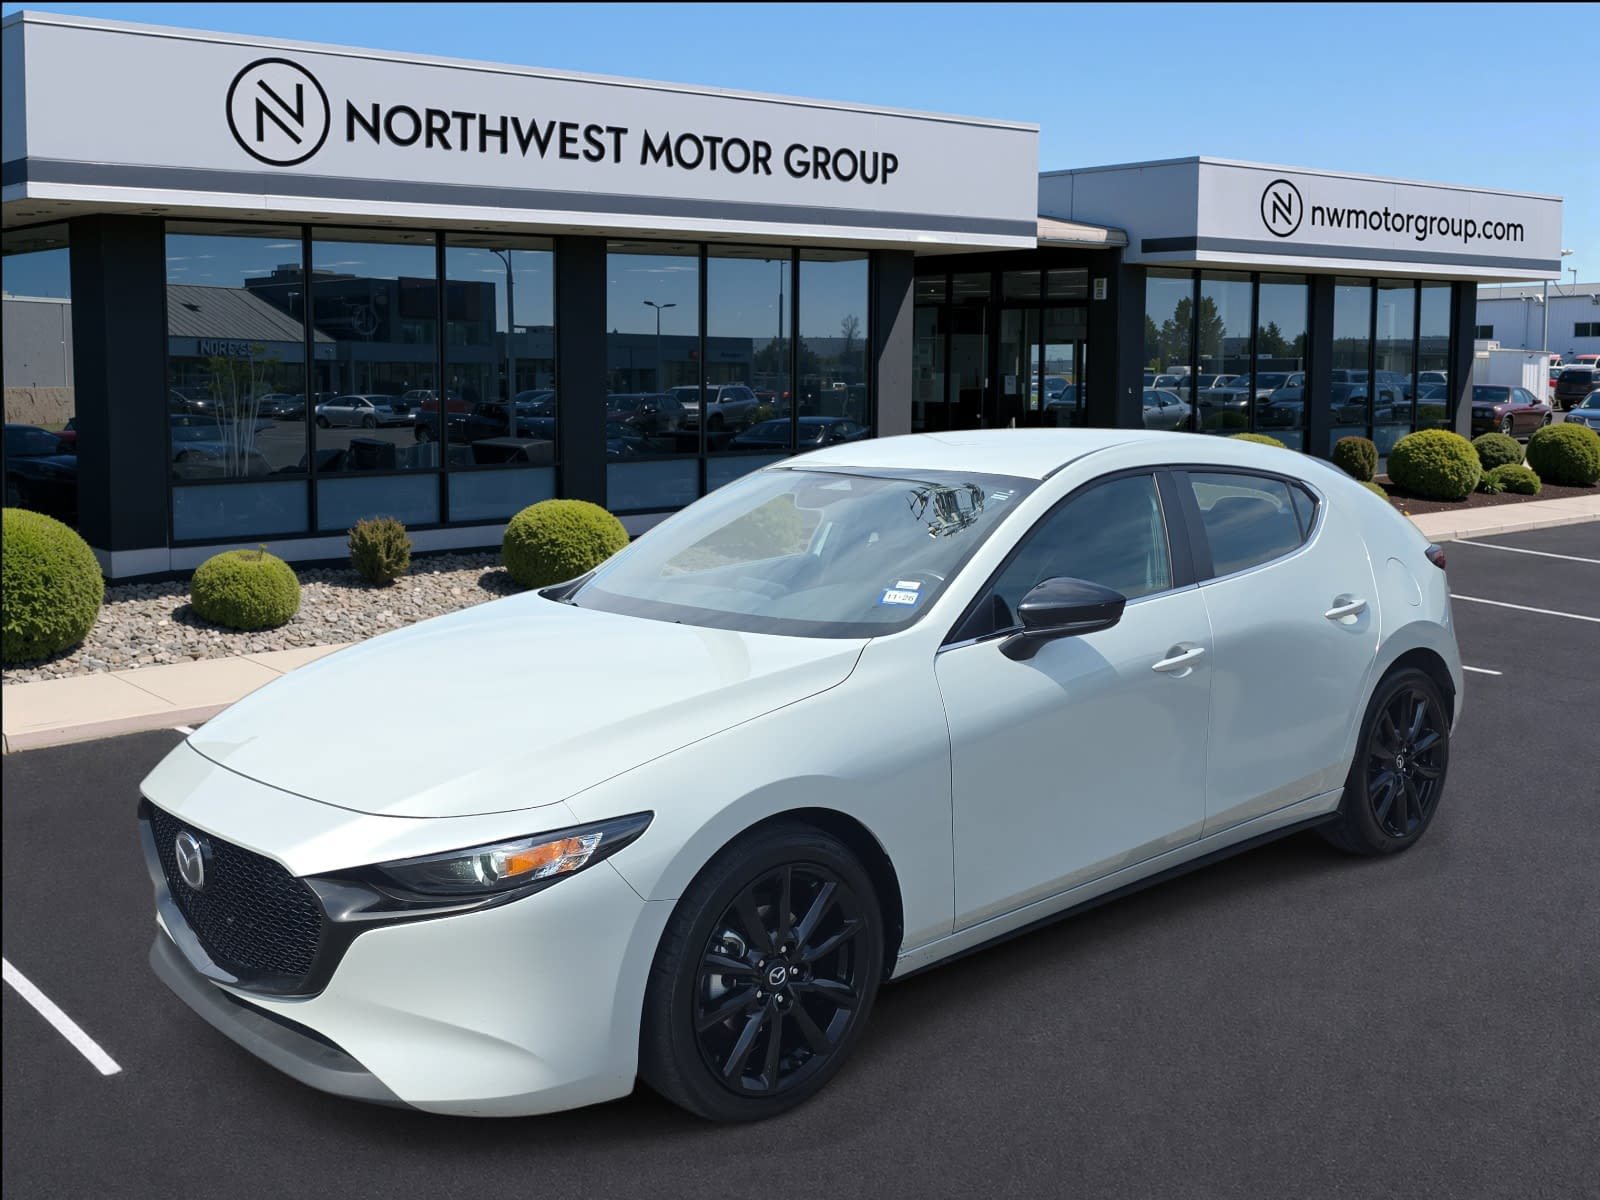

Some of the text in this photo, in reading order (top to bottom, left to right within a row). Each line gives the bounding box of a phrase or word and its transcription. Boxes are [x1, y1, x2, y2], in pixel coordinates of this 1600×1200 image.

[346, 98, 899, 185] NORTHWEST MOTOR GROUP
[1310, 205, 1524, 244] nwmotorgroup.com
